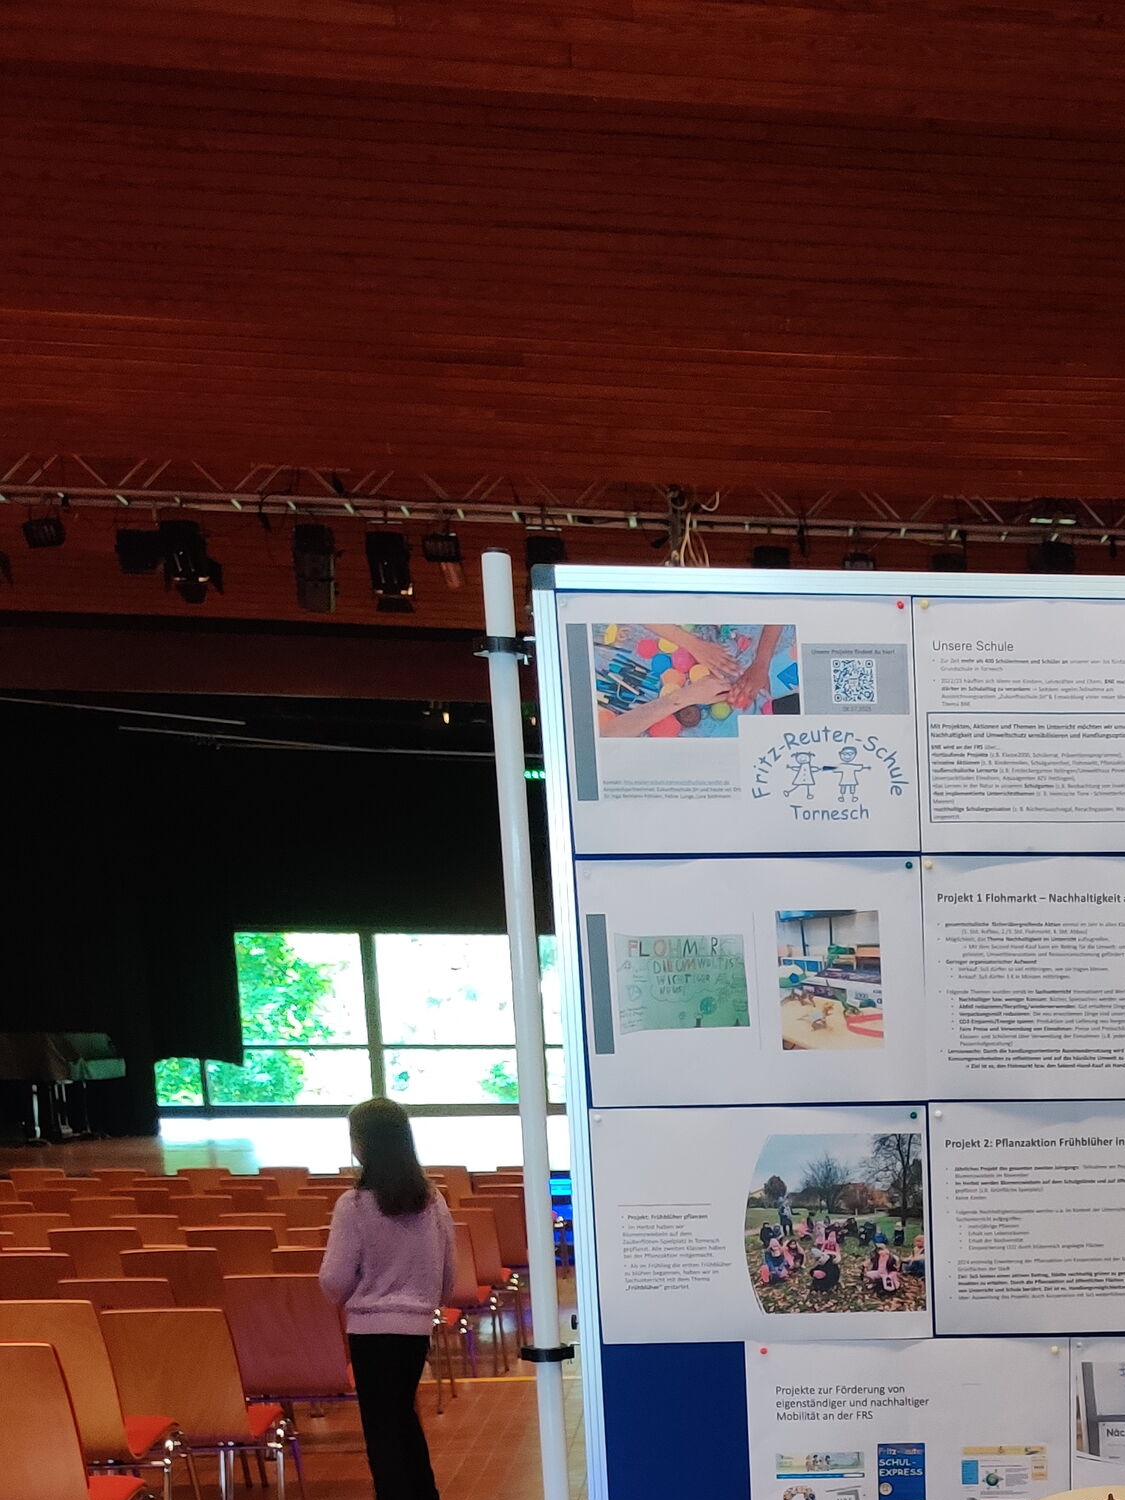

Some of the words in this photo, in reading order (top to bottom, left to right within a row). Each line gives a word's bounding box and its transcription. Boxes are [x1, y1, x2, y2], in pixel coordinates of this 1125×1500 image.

[932, 640, 973, 652] Unsere
[976, 640, 1014, 652] Schule
[751, 725, 909, 799] Fritz-Reuter-Schule
[790, 803, 870, 821] Tornesch
[937, 893, 974, 905] Projekt
[977, 894, 982, 903] 1
[985, 893, 1037, 903] Flohmarkt
[1048, 893, 1121, 905] Nachhaltigkeit
[945, 1139, 980, 1150] Projekt
[983, 1139, 993, 1148] 2:
[995, 1138, 1057, 1148] Pflanzaktion
[1059, 1137, 1113, 1147] Frühblüher
[1116, 1138, 1125, 1146] in
[776, 1386, 815, 1397] Projekte
[836, 1385, 885, 1395] Förderung
[776, 1398, 847, 1410] eigenständiger
[850, 1398, 867, 1407] und
[871, 1397, 929, 1407] nachhaltiger
[777, 1411, 819, 1421] Mobilität
[837, 1411, 853, 1420] der
[857, 1411, 873, 1419] FRS
[879, 1468, 923, 1476] EXPRESS
